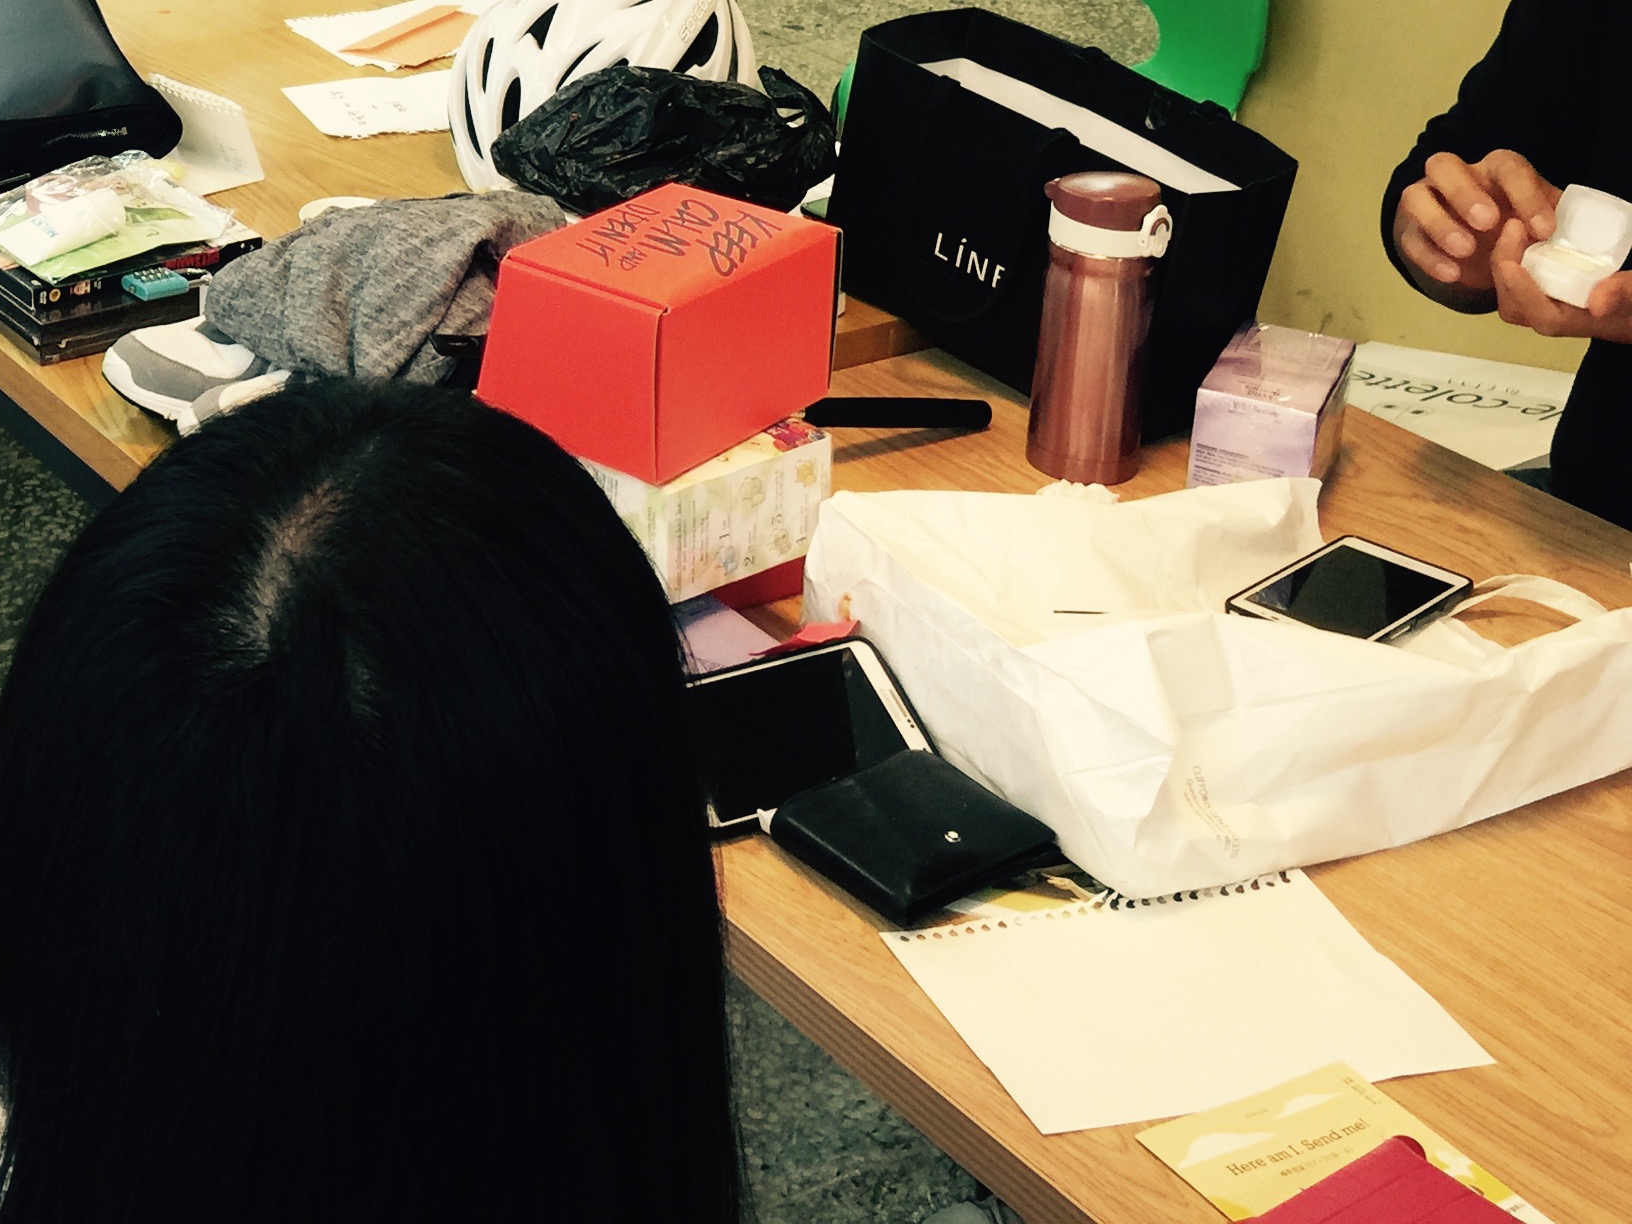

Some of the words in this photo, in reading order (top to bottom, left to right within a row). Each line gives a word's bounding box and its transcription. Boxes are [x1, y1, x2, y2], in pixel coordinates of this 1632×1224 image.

[637, 199, 720, 257] CALM
[696, 210, 782, 277] KEEP
[620, 246, 647, 271] AND
[1226, 1156, 1267, 1176] Here
[1267, 1147, 1292, 1164] am
[1301, 1129, 1343, 1151] Send
[1341, 1118, 1371, 1136] me!
